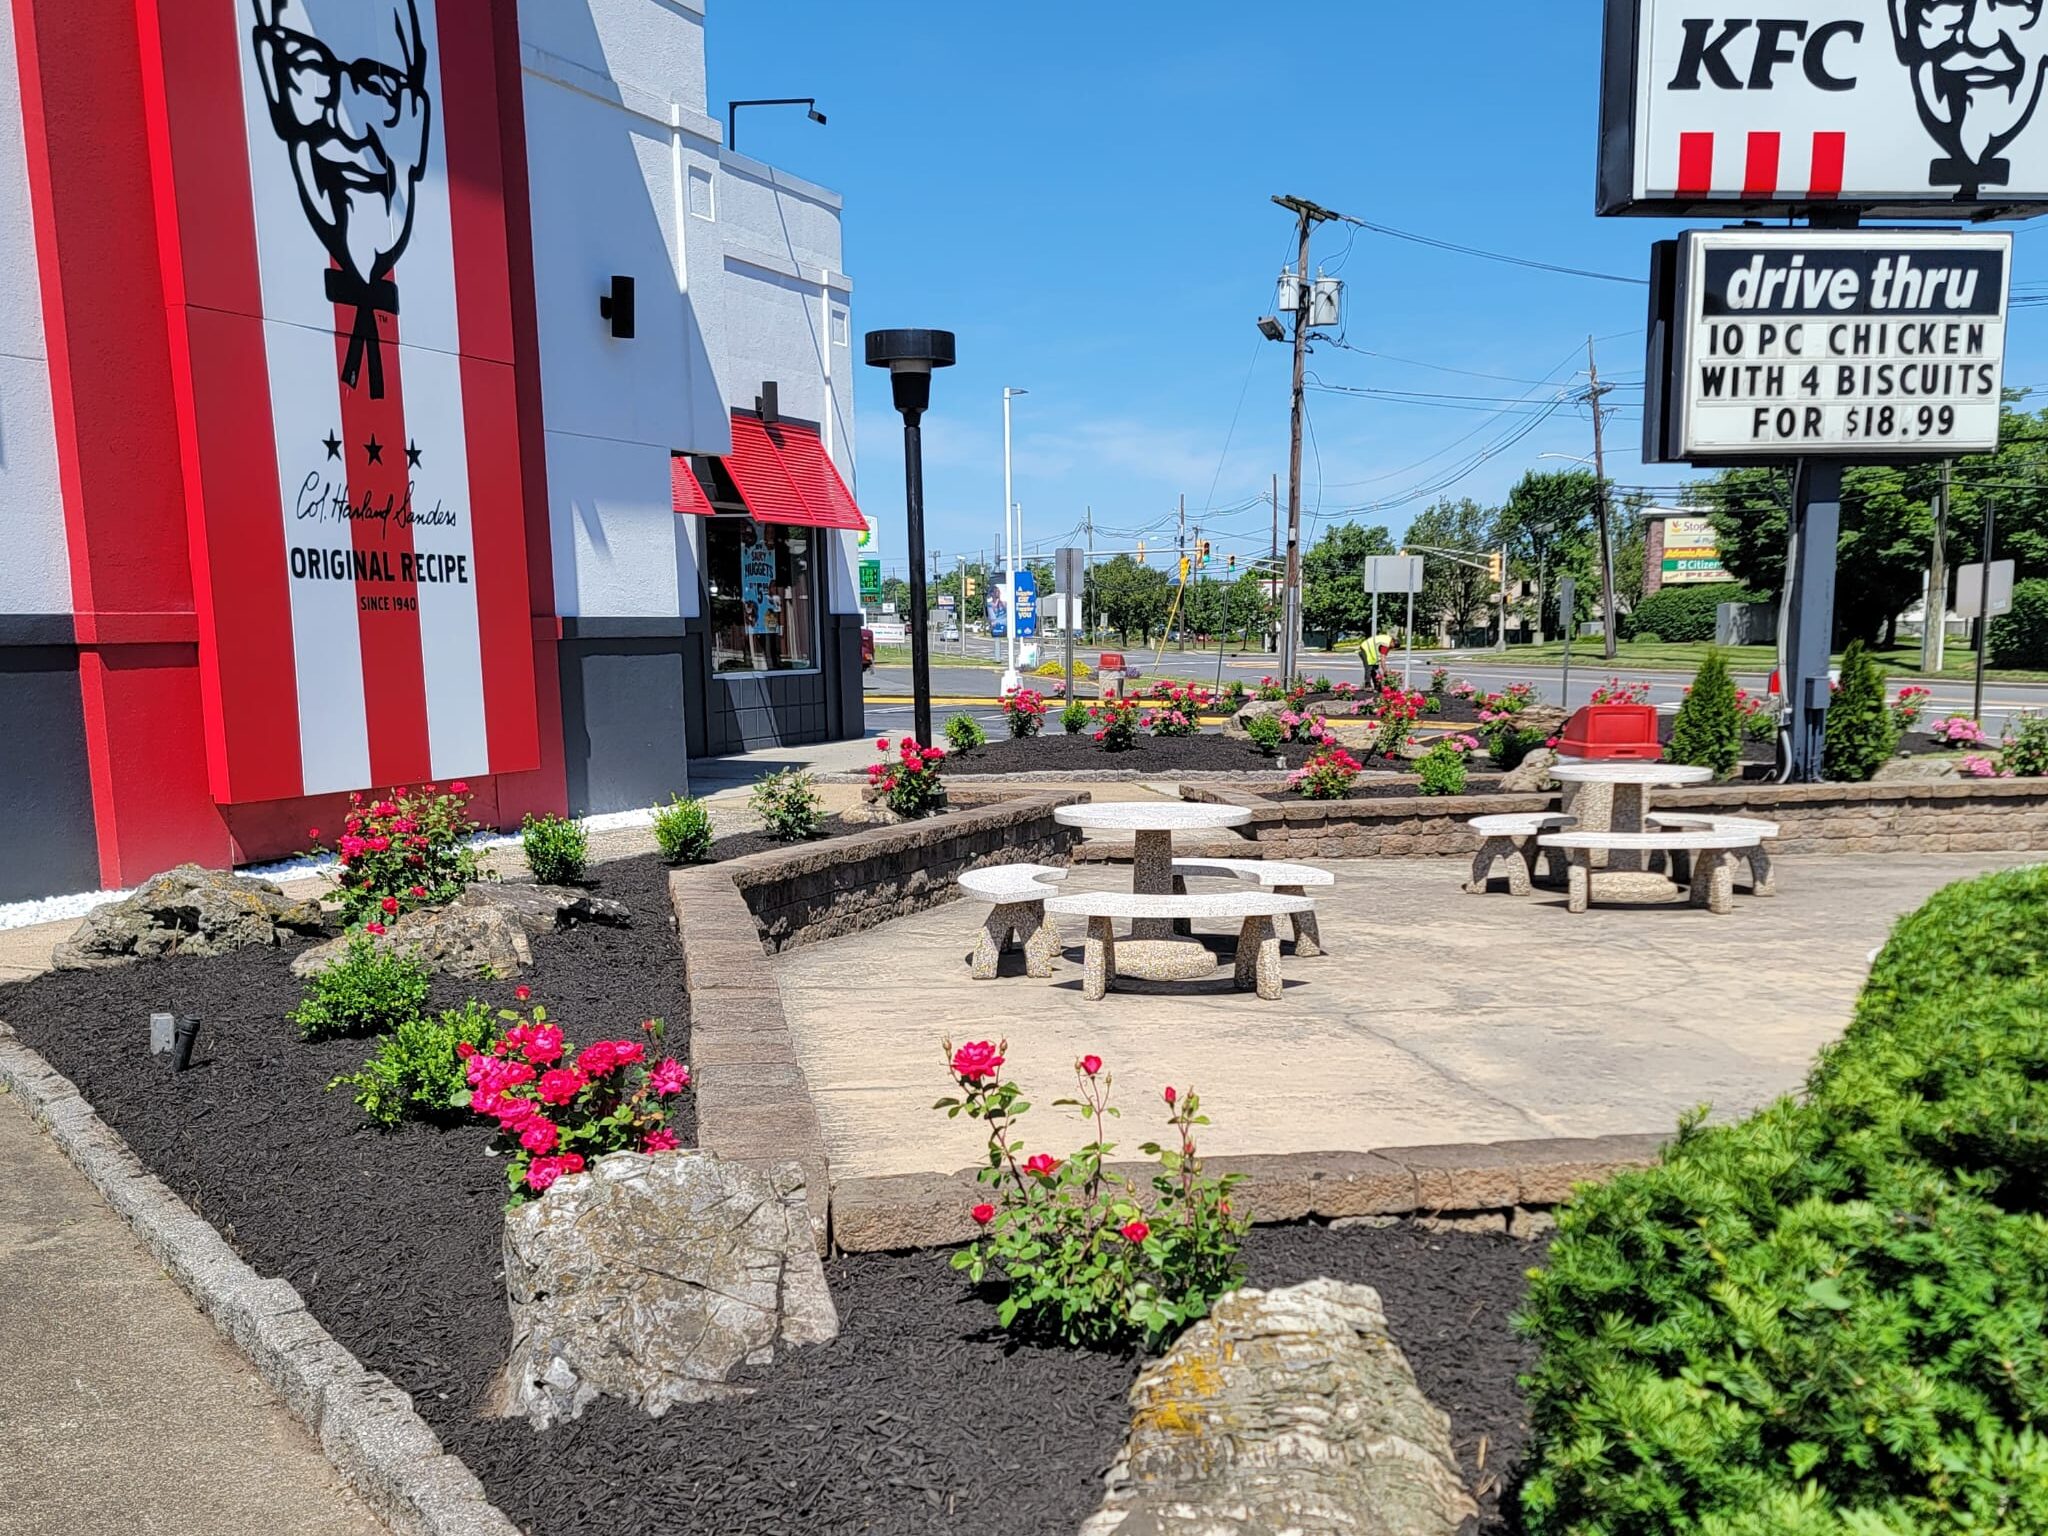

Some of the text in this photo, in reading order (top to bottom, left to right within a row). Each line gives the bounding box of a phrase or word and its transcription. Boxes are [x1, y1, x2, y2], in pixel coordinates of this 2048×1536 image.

[1667, 18, 1864, 92] KFC
[1726, 254, 1979, 310] drive thru
[1709, 322, 1984, 356] 10 PC CHICKEN
[1701, 362, 1994, 398] WITH 4 BISCUITS
[1752, 404, 1955, 438] FOR $18.99
[296, 470, 457, 541] Col. Harland Sanders
[290, 546, 469, 584] ORIGINAL RECIPE
[360, 596, 417, 612] SINCE 1940
